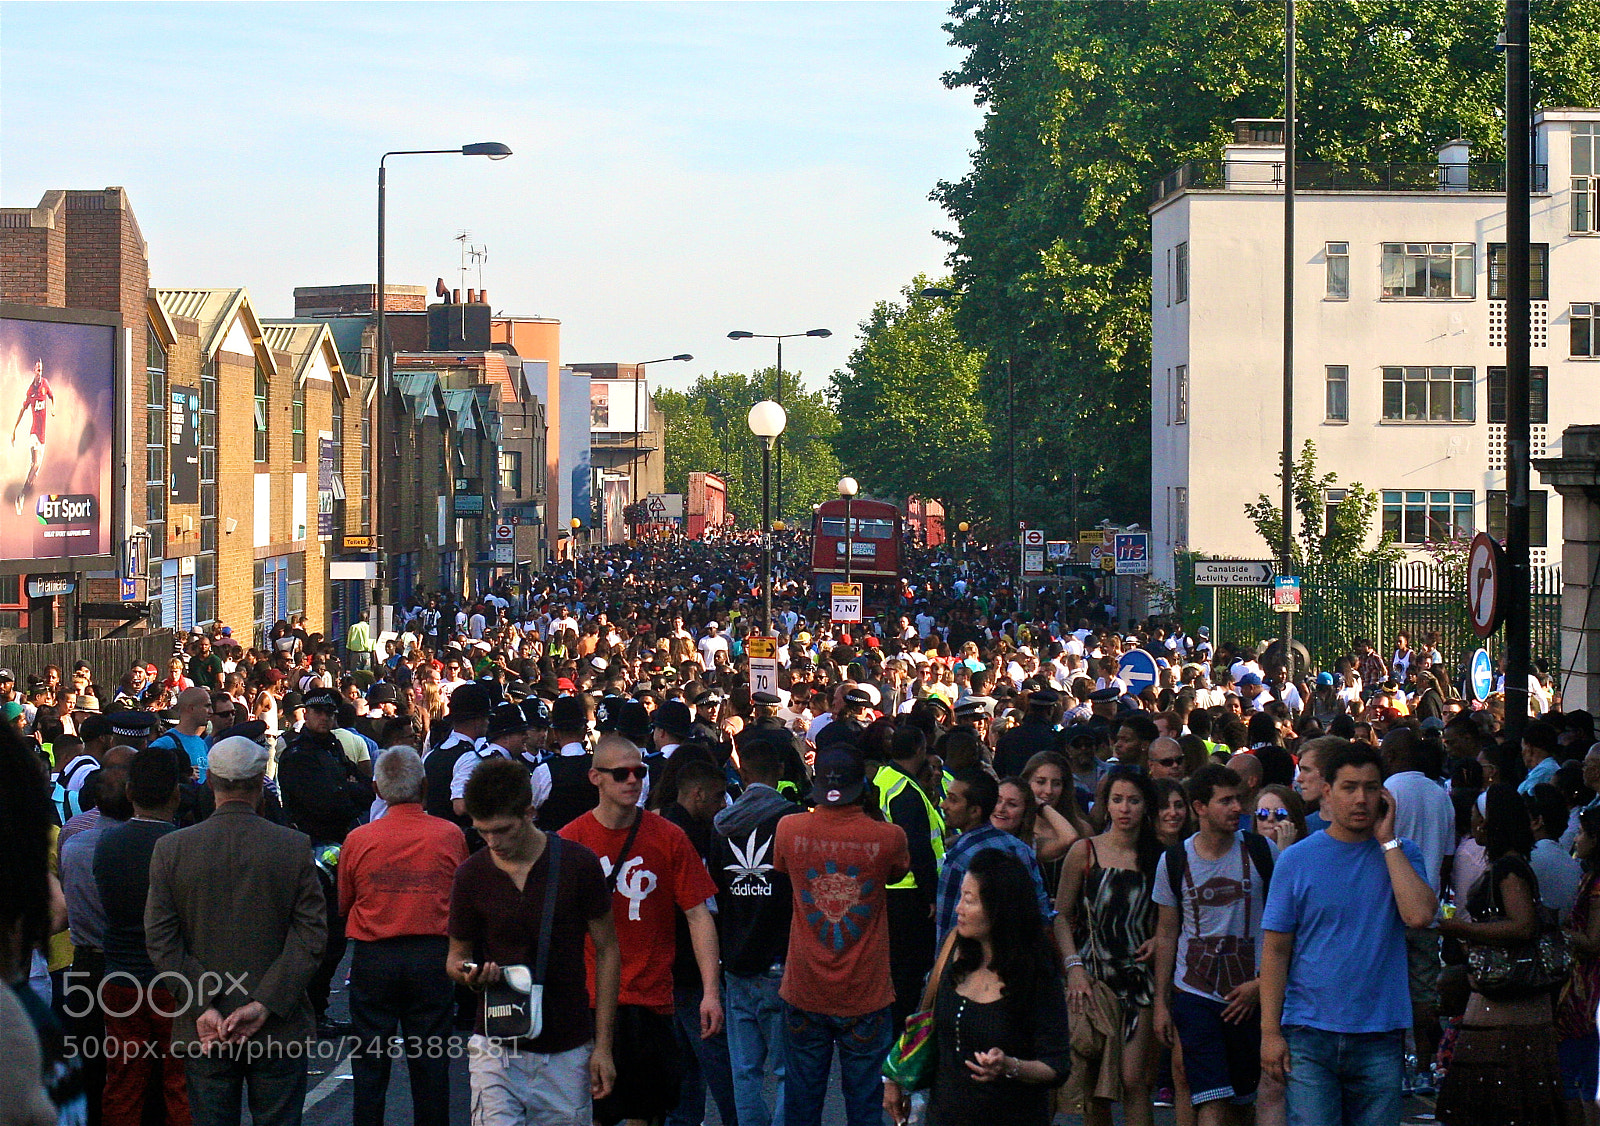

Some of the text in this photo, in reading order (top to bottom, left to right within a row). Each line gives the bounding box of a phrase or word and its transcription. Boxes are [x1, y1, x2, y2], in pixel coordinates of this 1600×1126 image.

[43, 498, 91, 522] BT Sport
[1019, 521, 1026, 529] R
[1206, 565, 1249, 573] Canalside
[1195, 574, 1261, 583] Activity Centre
[845, 604, 858, 613] N7
[756, 674, 768, 690] 70
[487, 1004, 512, 1018] PUMA
